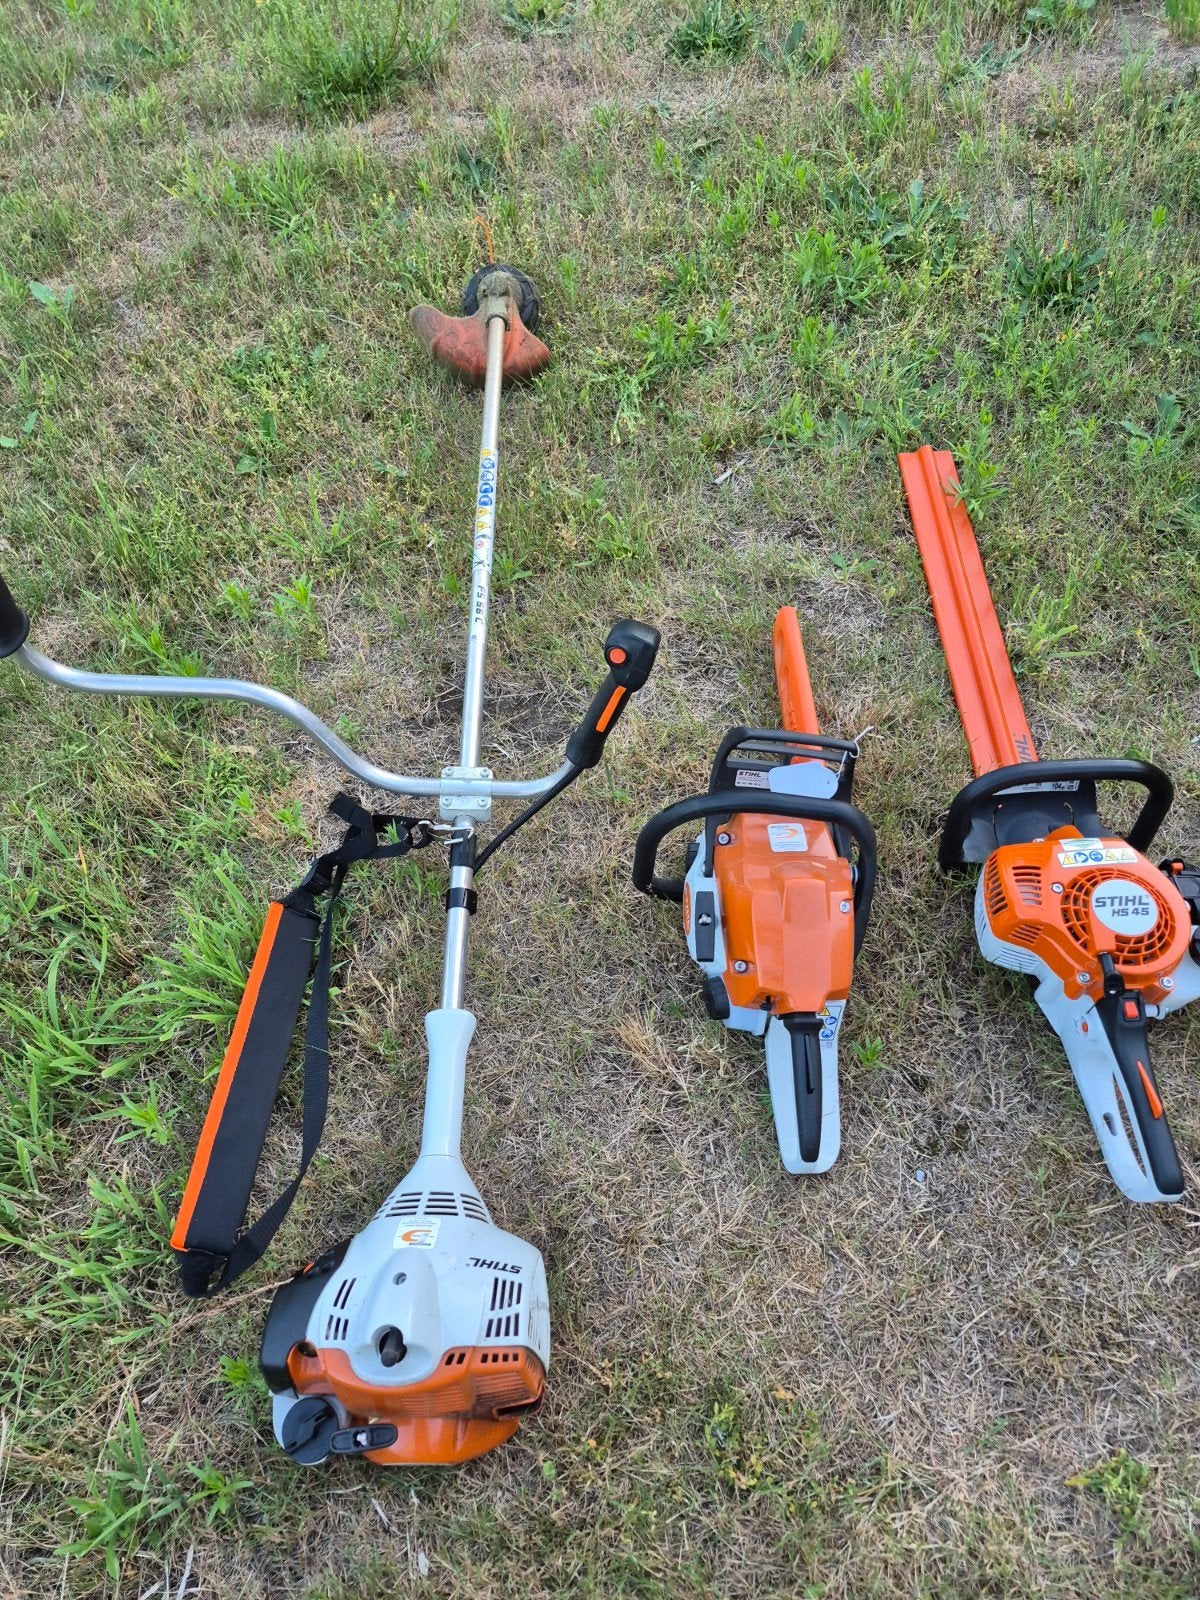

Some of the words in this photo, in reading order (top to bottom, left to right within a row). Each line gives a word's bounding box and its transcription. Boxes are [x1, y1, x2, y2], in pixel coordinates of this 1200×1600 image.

[476, 585, 486, 599] FS
[738, 770, 762, 778] STIHL
[1094, 895, 1150, 908] STIHL
[1111, 908, 1129, 917] HS
[1131, 907, 1150, 916] 45
[468, 1257, 523, 1275] STIHL
